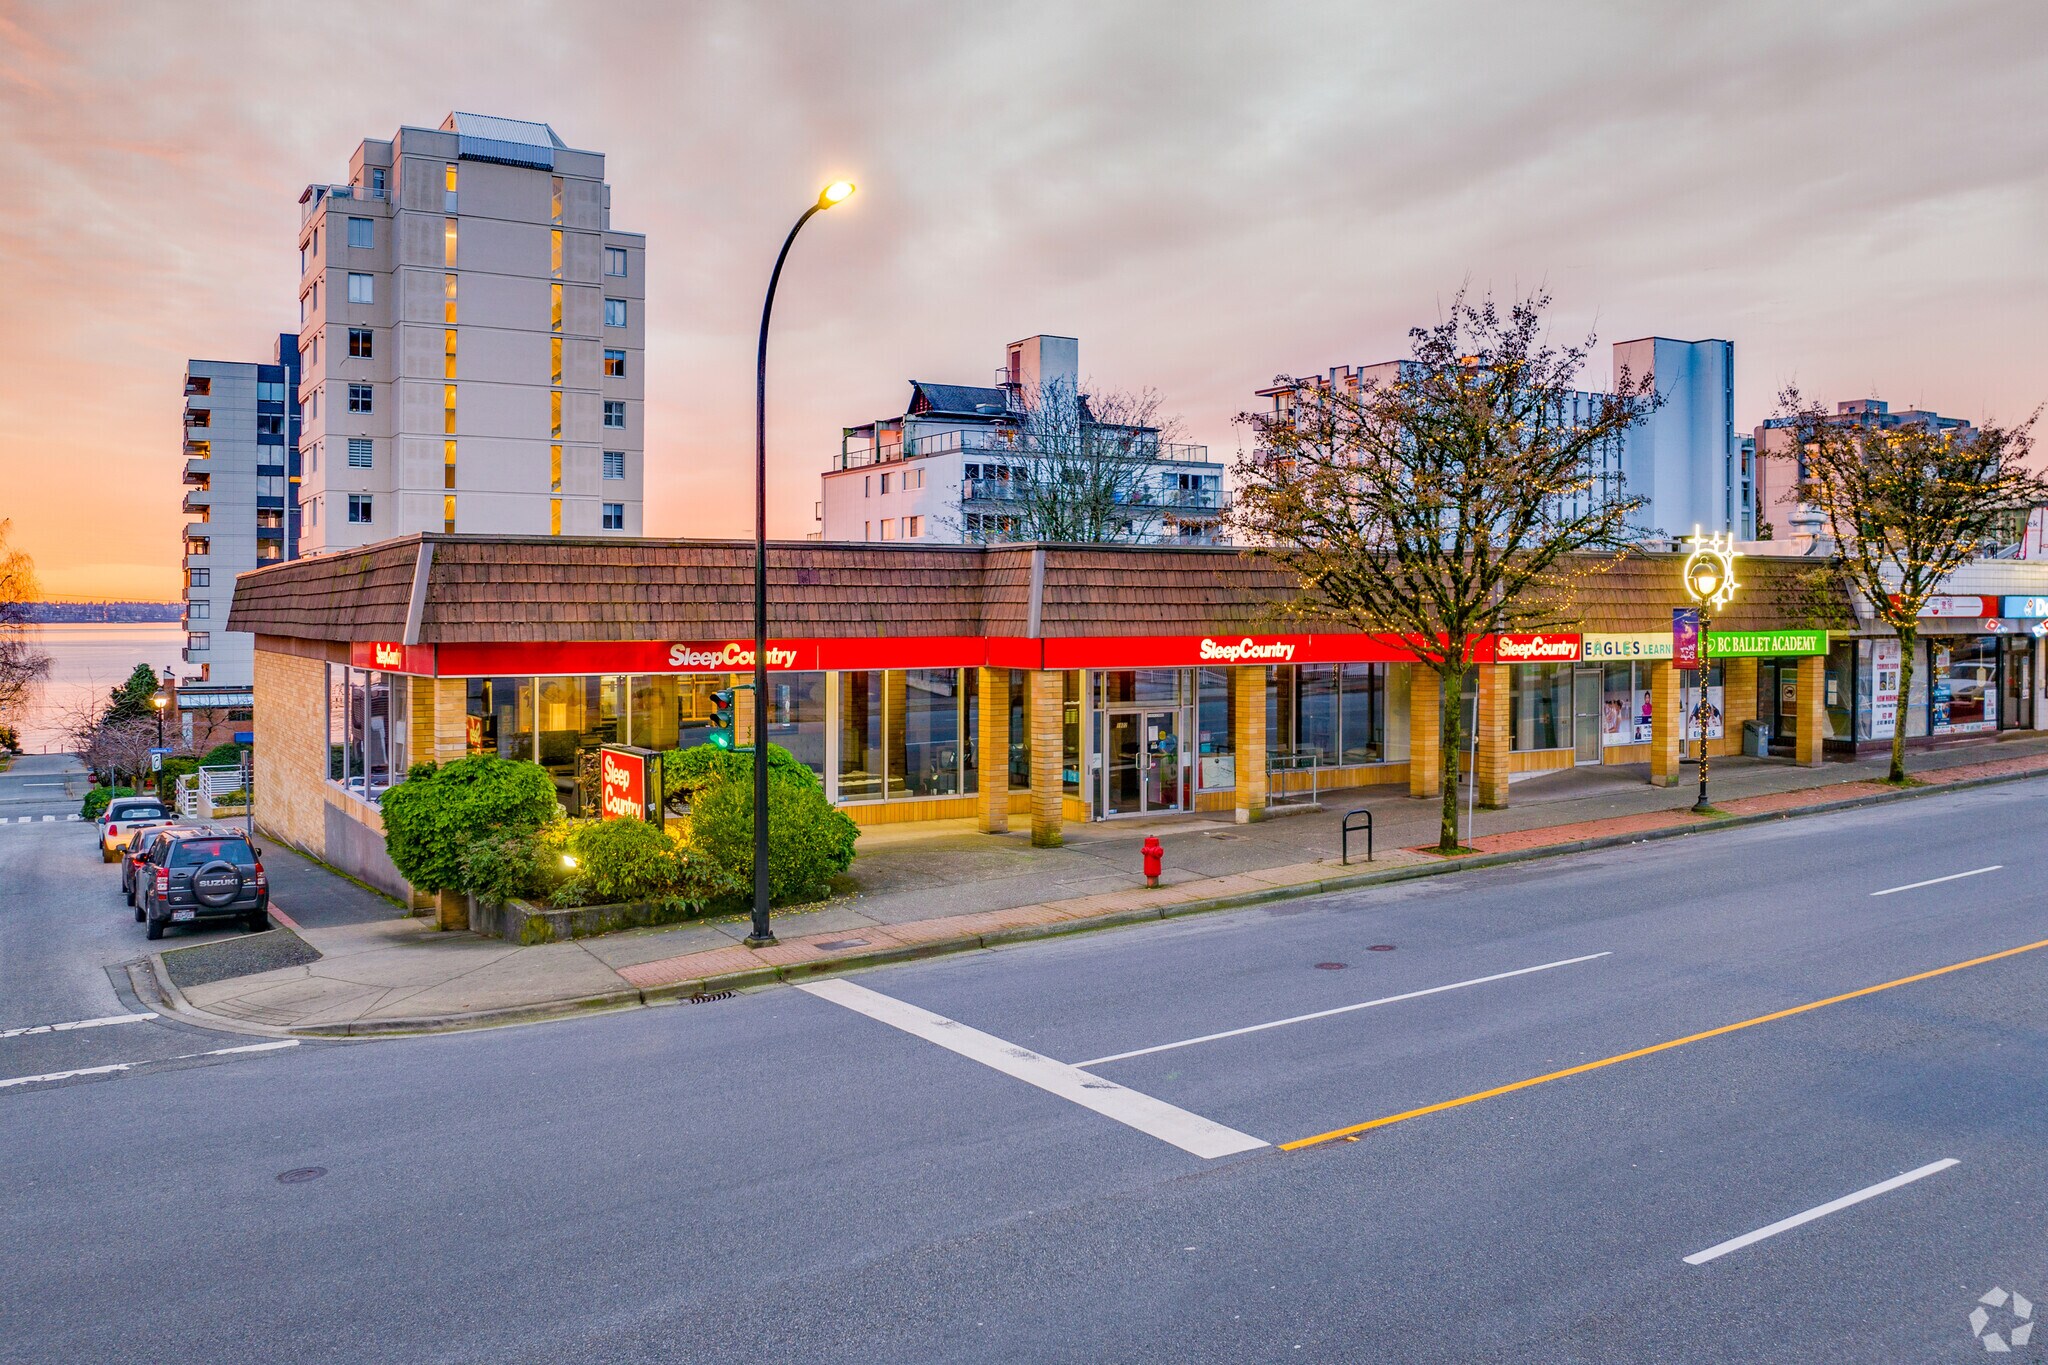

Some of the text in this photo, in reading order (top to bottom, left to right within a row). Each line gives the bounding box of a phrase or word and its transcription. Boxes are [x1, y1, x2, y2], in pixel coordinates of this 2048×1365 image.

[1200, 638, 1295, 662] SleepCountry
[1498, 636, 1578, 659] SleepCountry
[1585, 641, 1674, 656] EAGLES LEARN
[1717, 635, 1817, 652] BC BALLET ACADEMY
[604, 755, 630, 792] Sleep
[605, 784, 642, 819] Country
[199, 878, 239, 887] SUZUKI
